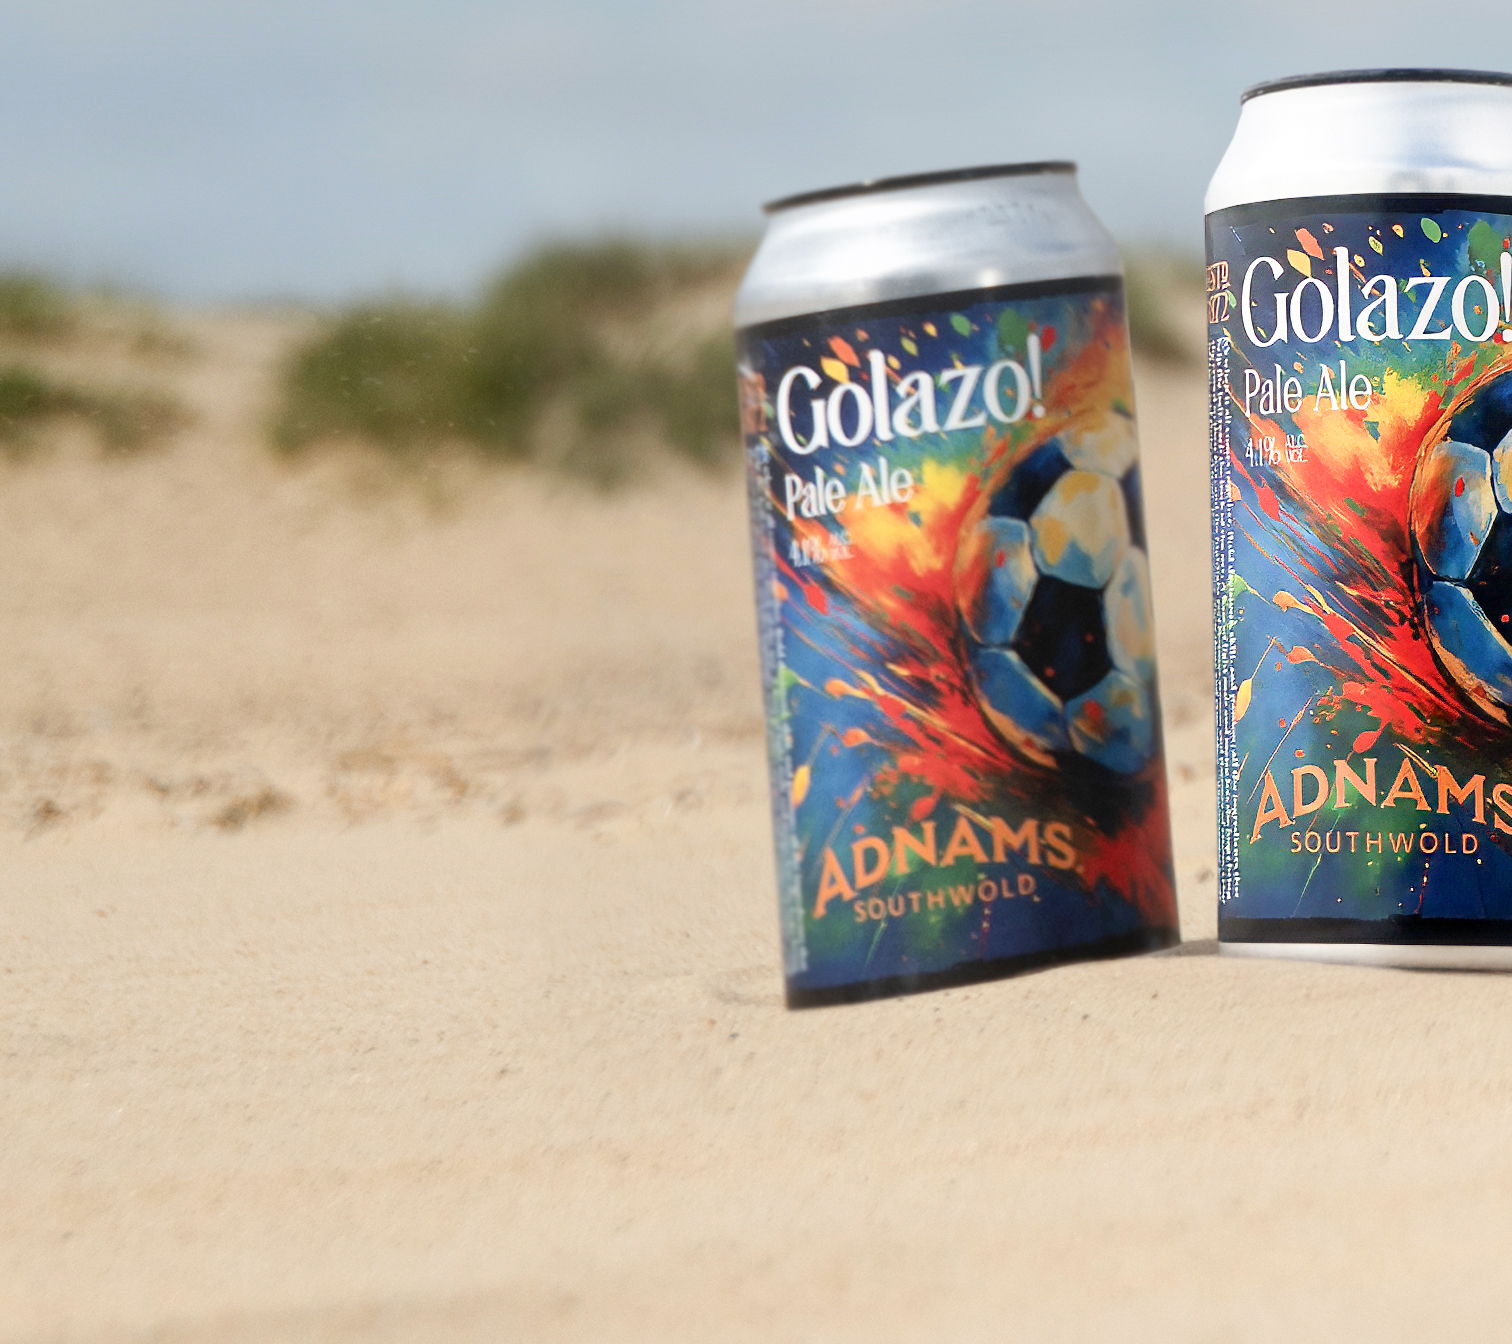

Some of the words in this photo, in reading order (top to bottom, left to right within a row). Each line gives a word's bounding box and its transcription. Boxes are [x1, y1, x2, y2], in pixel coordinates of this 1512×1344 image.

[776, 332, 1046, 456] Golazo!
[1244, 362, 1303, 418] Pale
[1312, 359, 1374, 412] Ale
[784, 465, 847, 521] Pale
[855, 456, 915, 511] Ale
[812, 815, 1077, 920] ADNAMS
[1290, 830, 1480, 854] SOUTHWOLD
[853, 873, 1038, 924] SOUTHWOLD
